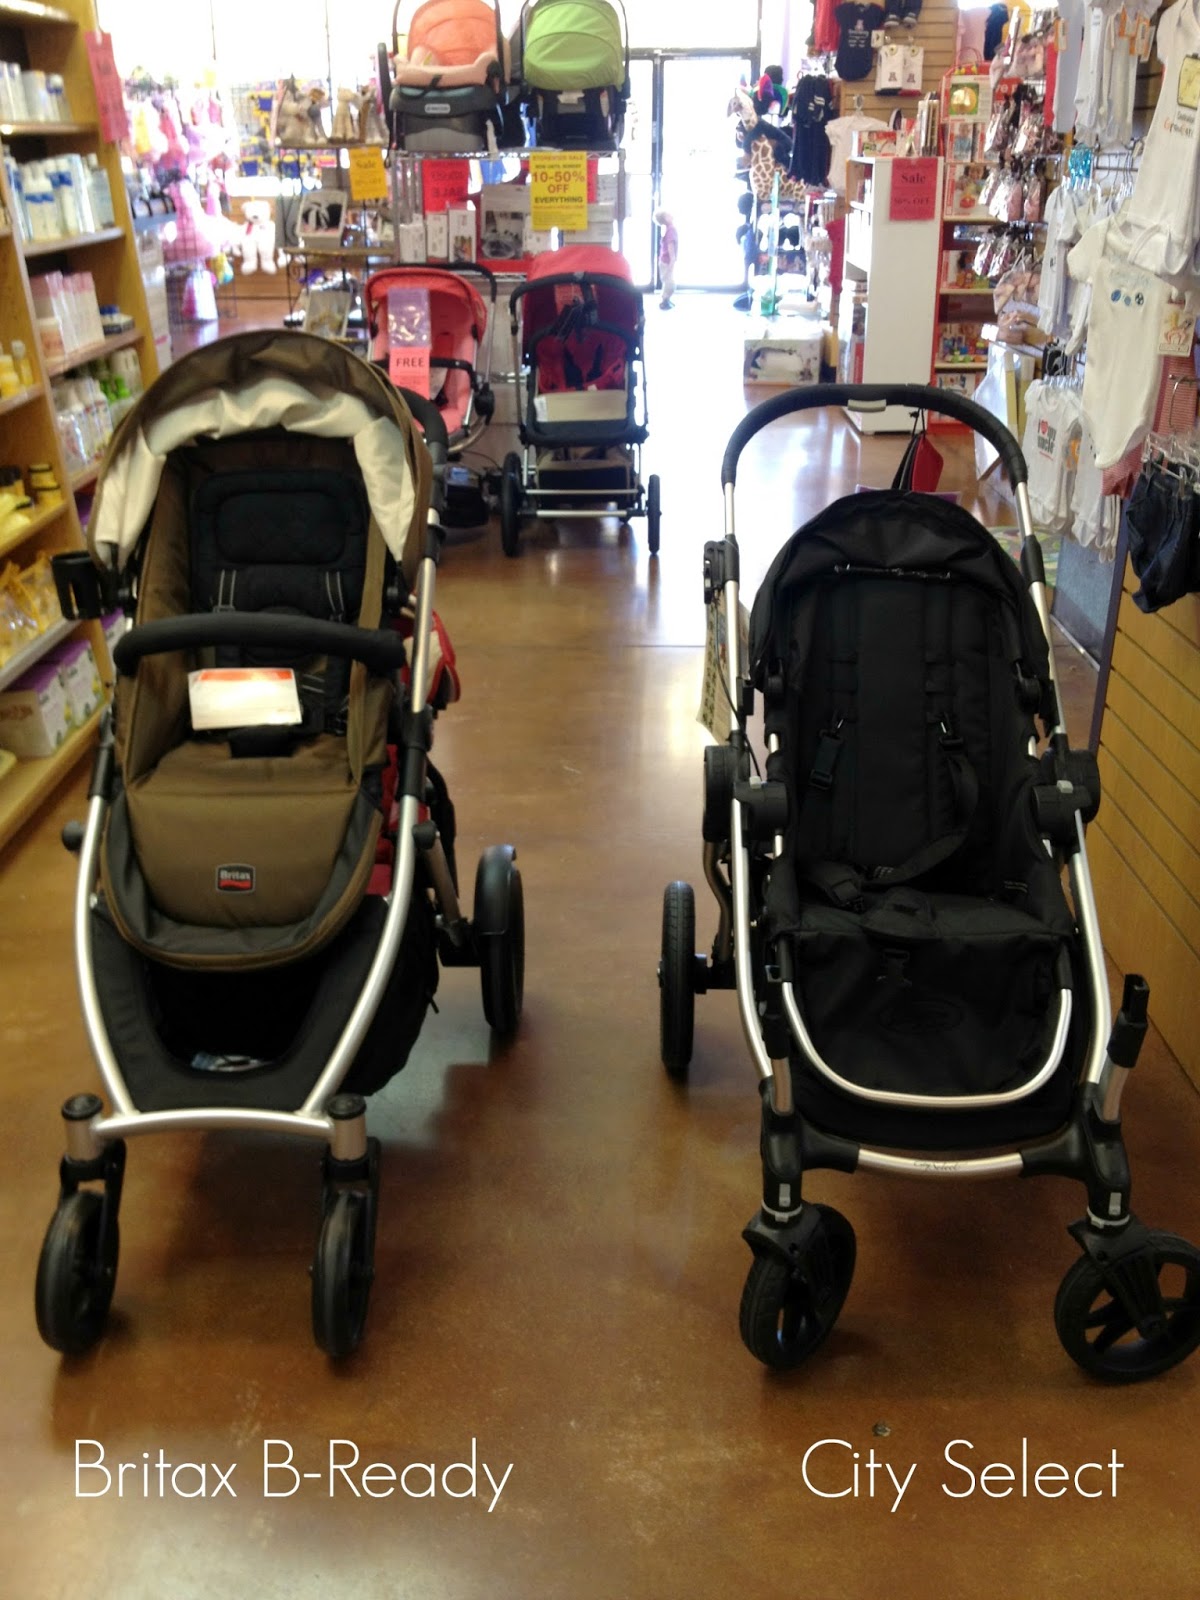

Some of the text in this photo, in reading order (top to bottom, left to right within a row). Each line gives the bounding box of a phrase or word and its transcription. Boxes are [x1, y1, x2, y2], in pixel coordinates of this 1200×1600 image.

[533, 171, 585, 183] 10-50%
[901, 172, 926, 185] Sale
[547, 184, 569, 194] OFF
[534, 196, 584, 204] EVERYTHING
[395, 357, 425, 368] FREE
[220, 869, 251, 880] Britax
